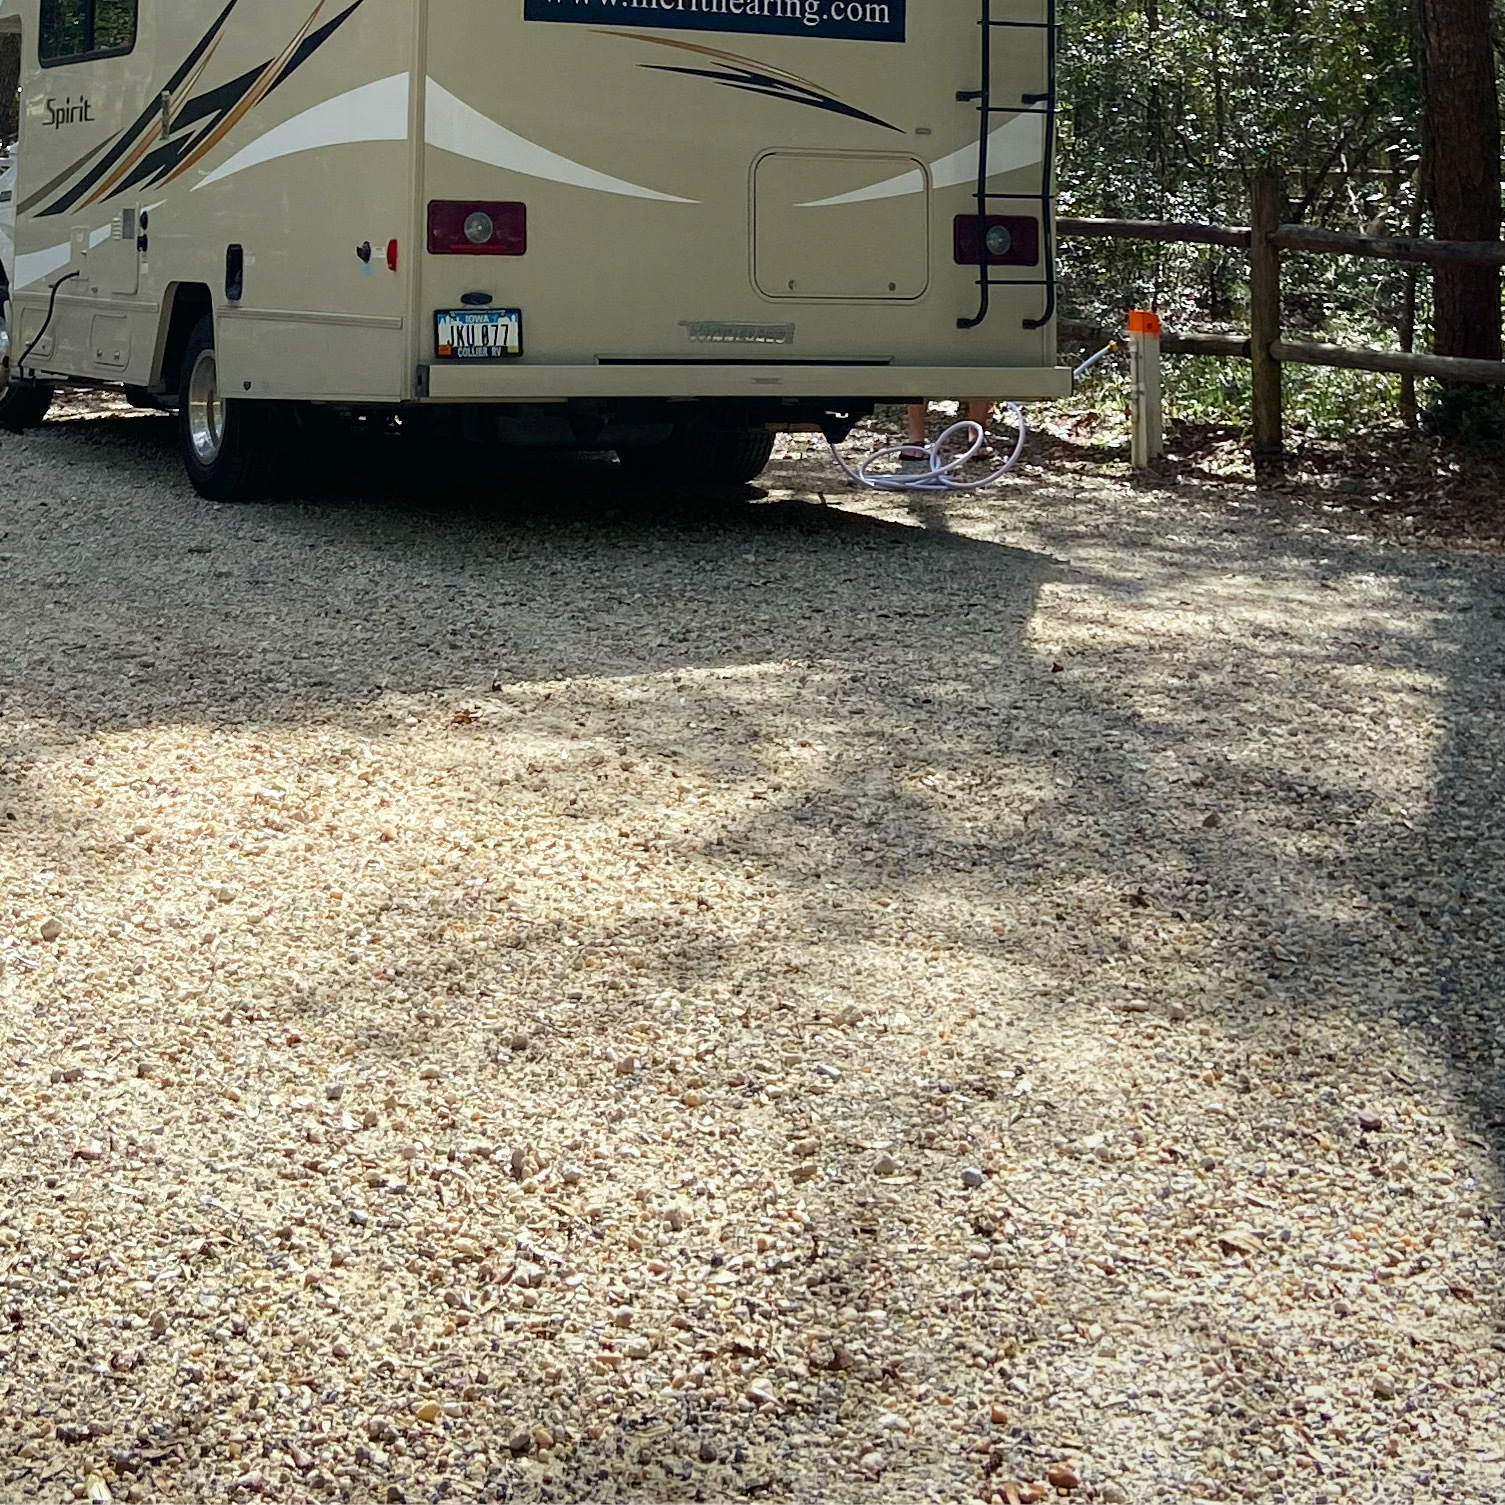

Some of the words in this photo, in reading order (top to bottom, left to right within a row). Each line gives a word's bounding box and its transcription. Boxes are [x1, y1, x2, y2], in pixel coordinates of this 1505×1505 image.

[42, 95, 95, 130] Spirit
[464, 314, 490, 323] IOWA
[447, 324, 475, 346] JKU
